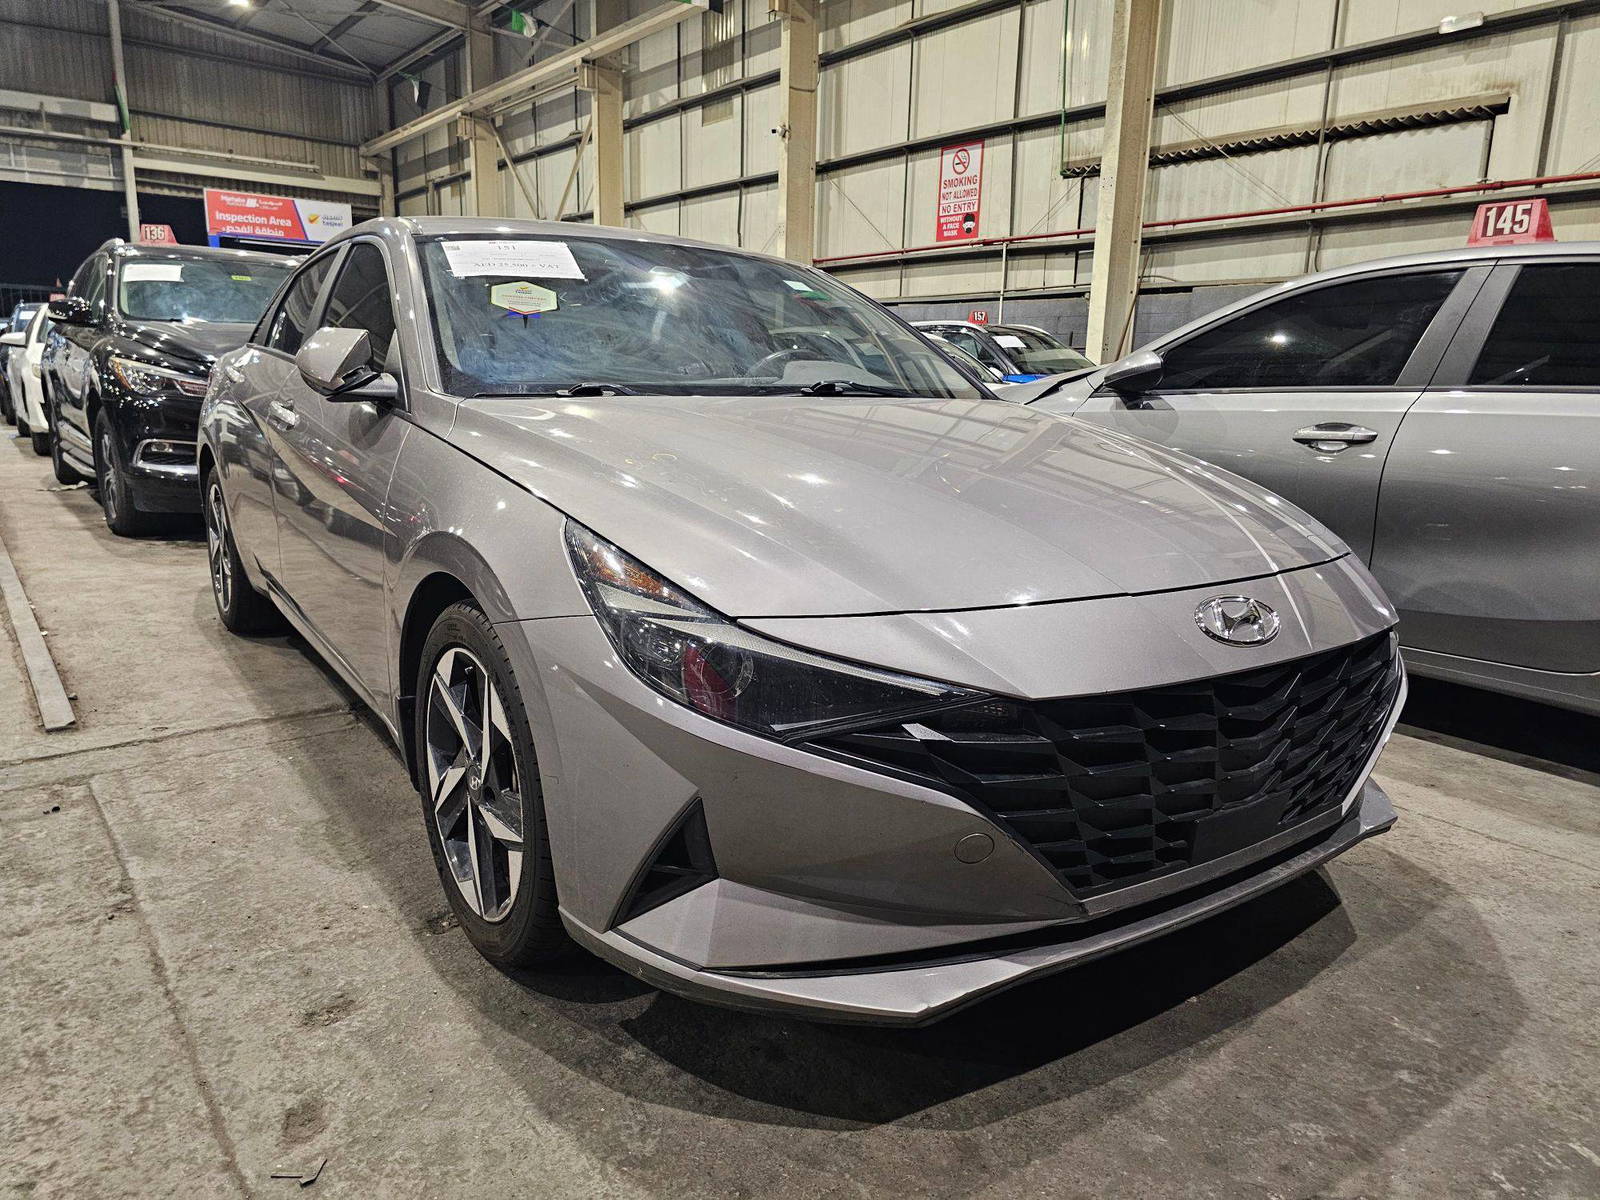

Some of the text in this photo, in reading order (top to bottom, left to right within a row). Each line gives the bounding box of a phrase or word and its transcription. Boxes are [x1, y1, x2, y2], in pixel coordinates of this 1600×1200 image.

[943, 175, 977, 189] SMOKING
[942, 188, 977, 201] NOT ALLOWED
[941, 201, 976, 214] NO ENTRY
[215, 210, 292, 227] Inspection Area
[1486, 203, 1532, 237] 145
[145, 226, 166, 240] 136
[974, 311, 986, 321] 157
